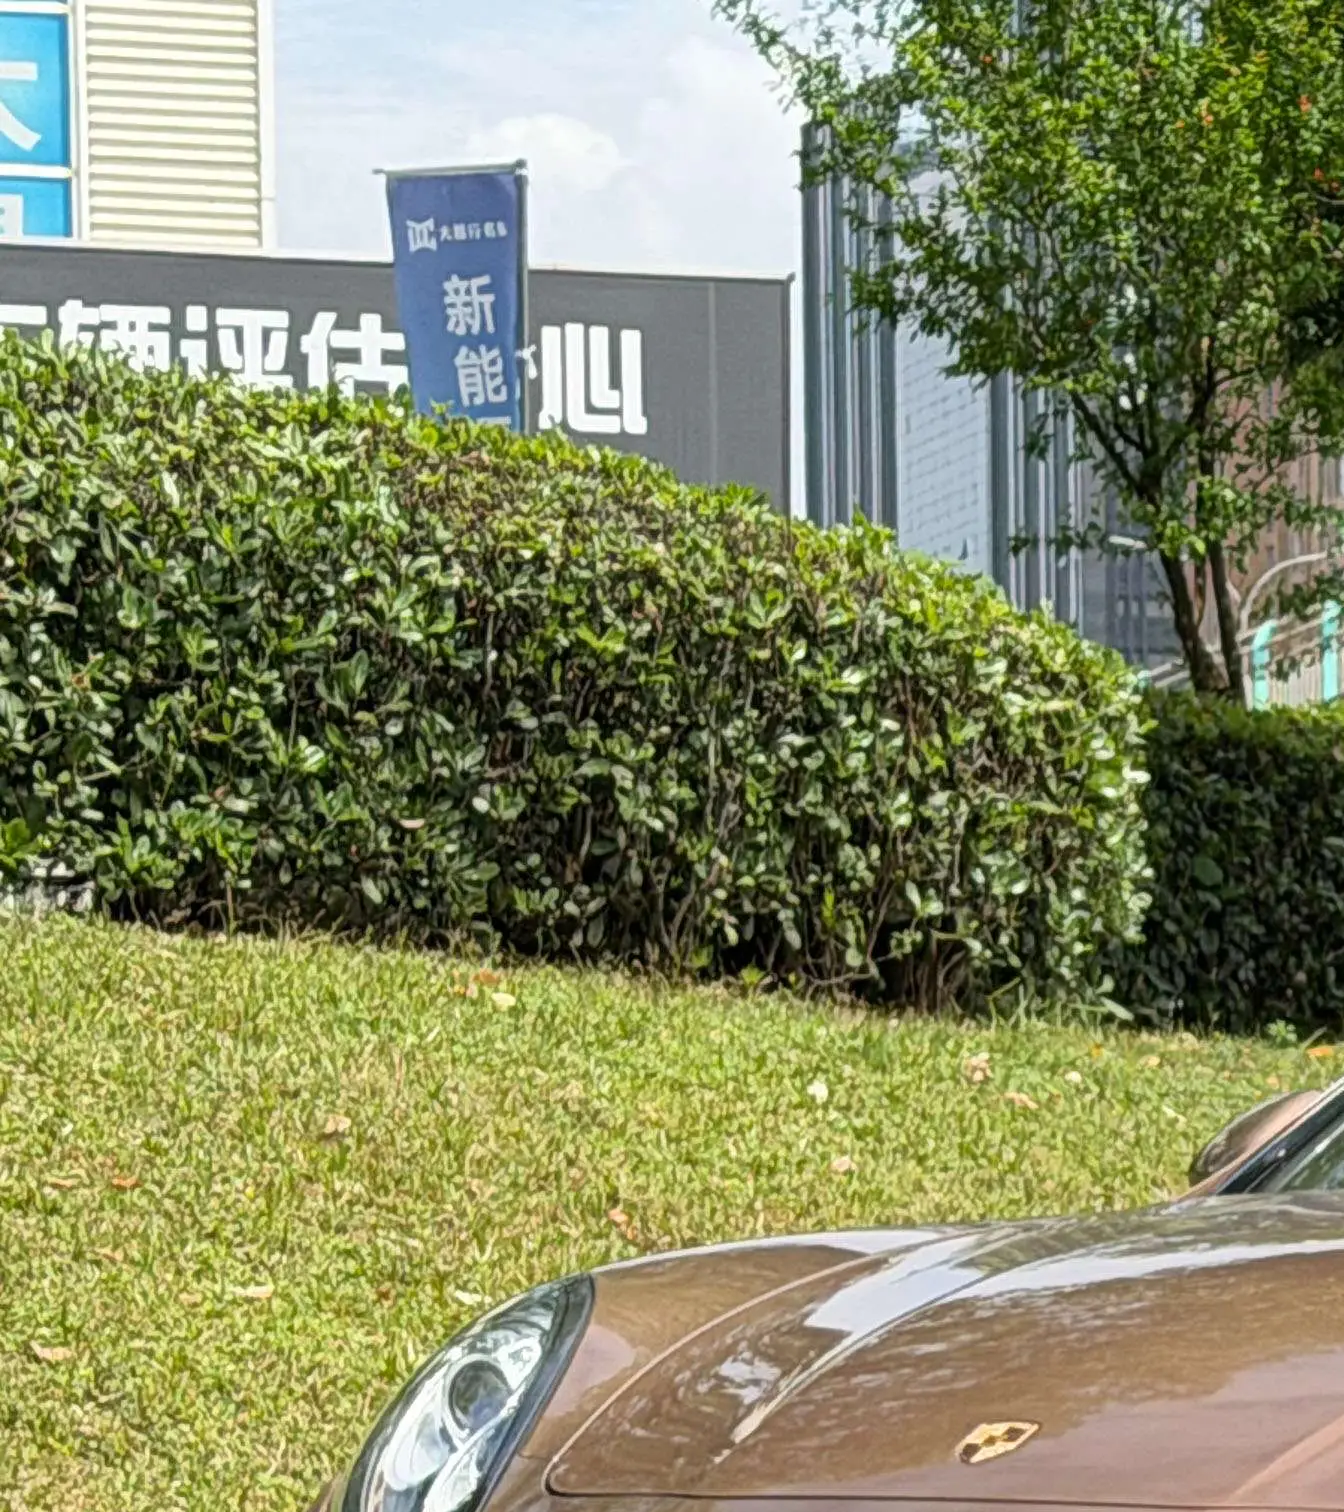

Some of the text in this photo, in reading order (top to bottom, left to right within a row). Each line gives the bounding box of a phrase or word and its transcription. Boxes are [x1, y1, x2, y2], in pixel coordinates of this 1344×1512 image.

[0, 299, 648, 435] 辆评估心
[443, 274, 511, 424] 新能
